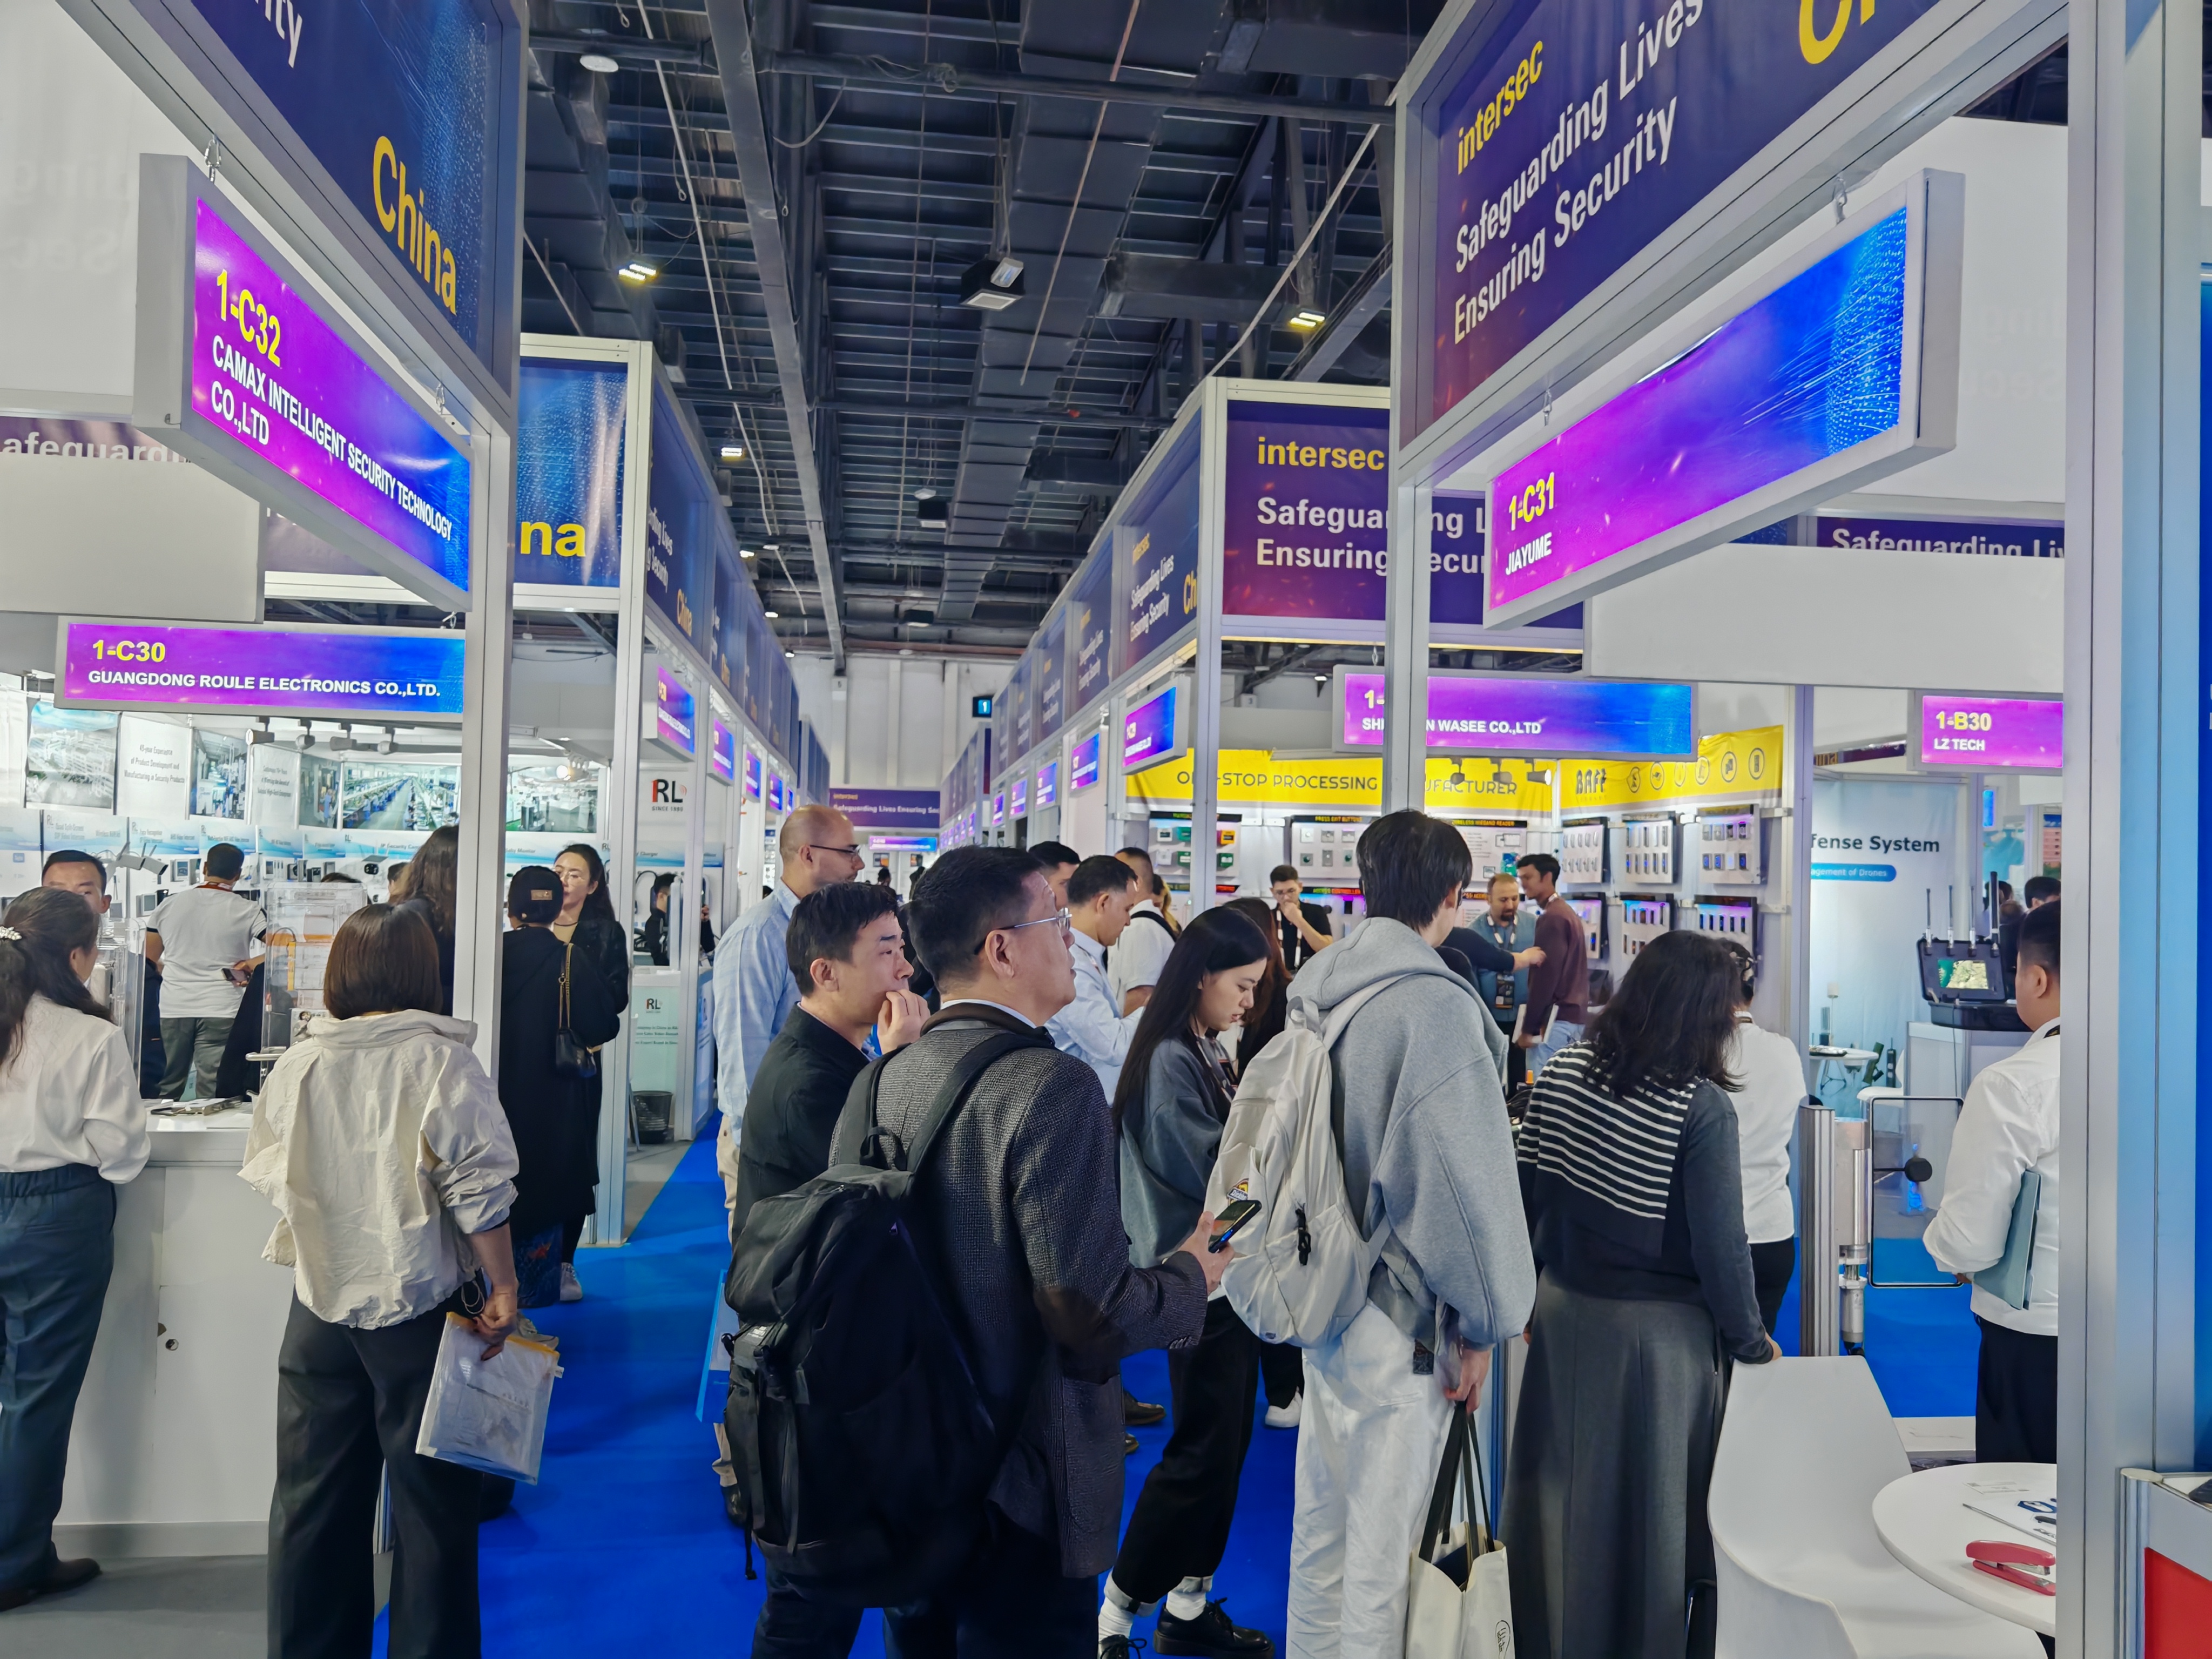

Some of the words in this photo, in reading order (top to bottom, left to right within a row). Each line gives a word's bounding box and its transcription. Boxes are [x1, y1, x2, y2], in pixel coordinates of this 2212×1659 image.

[1457, 40, 1544, 176] intersec
[1455, 79, 1609, 274] Safeguarding
[1620, 0, 1704, 101] Lives
[372, 136, 457, 315] China
[1454, 228, 1546, 346] Ensuring
[1554, 97, 1677, 248] Security
[217, 269, 281, 367] 1-C32
[211, 381, 269, 446] CO.,LTD
[212, 335, 266, 402] CAMAX
[269, 379, 347, 462] INTELLIGENT
[347, 442, 396, 499] SECURITY
[397, 480, 453, 541] TECHNOLOGY
[1257, 436, 1385, 470] intersec
[1508, 471, 1555, 531] 1-C31
[1505, 531, 1553, 576] JIAYUME
[92, 639, 166, 663] 1-C30
[88, 670, 196, 688] GUANGDONG
[199, 675, 255, 690] ROULE
[259, 676, 371, 695] ELECTRONICS
[375, 680, 441, 698] CO.,LTD.
[982, 700, 988, 713] 1
[1438, 720, 1486, 733] WASEE
[1489, 721, 1542, 735] CO.,LTD
[1936, 711, 1992, 732] 1-B30
[1933, 738, 1950, 751] LZ
[1951, 738, 1986, 752] TECH
[651, 779, 684, 803] RL
[1273, 774, 1378, 791] PROCESSING
[1869, 835, 1940, 854] System
[1859, 868, 1887, 876] Drones
[645, 998, 661, 1010] RL
